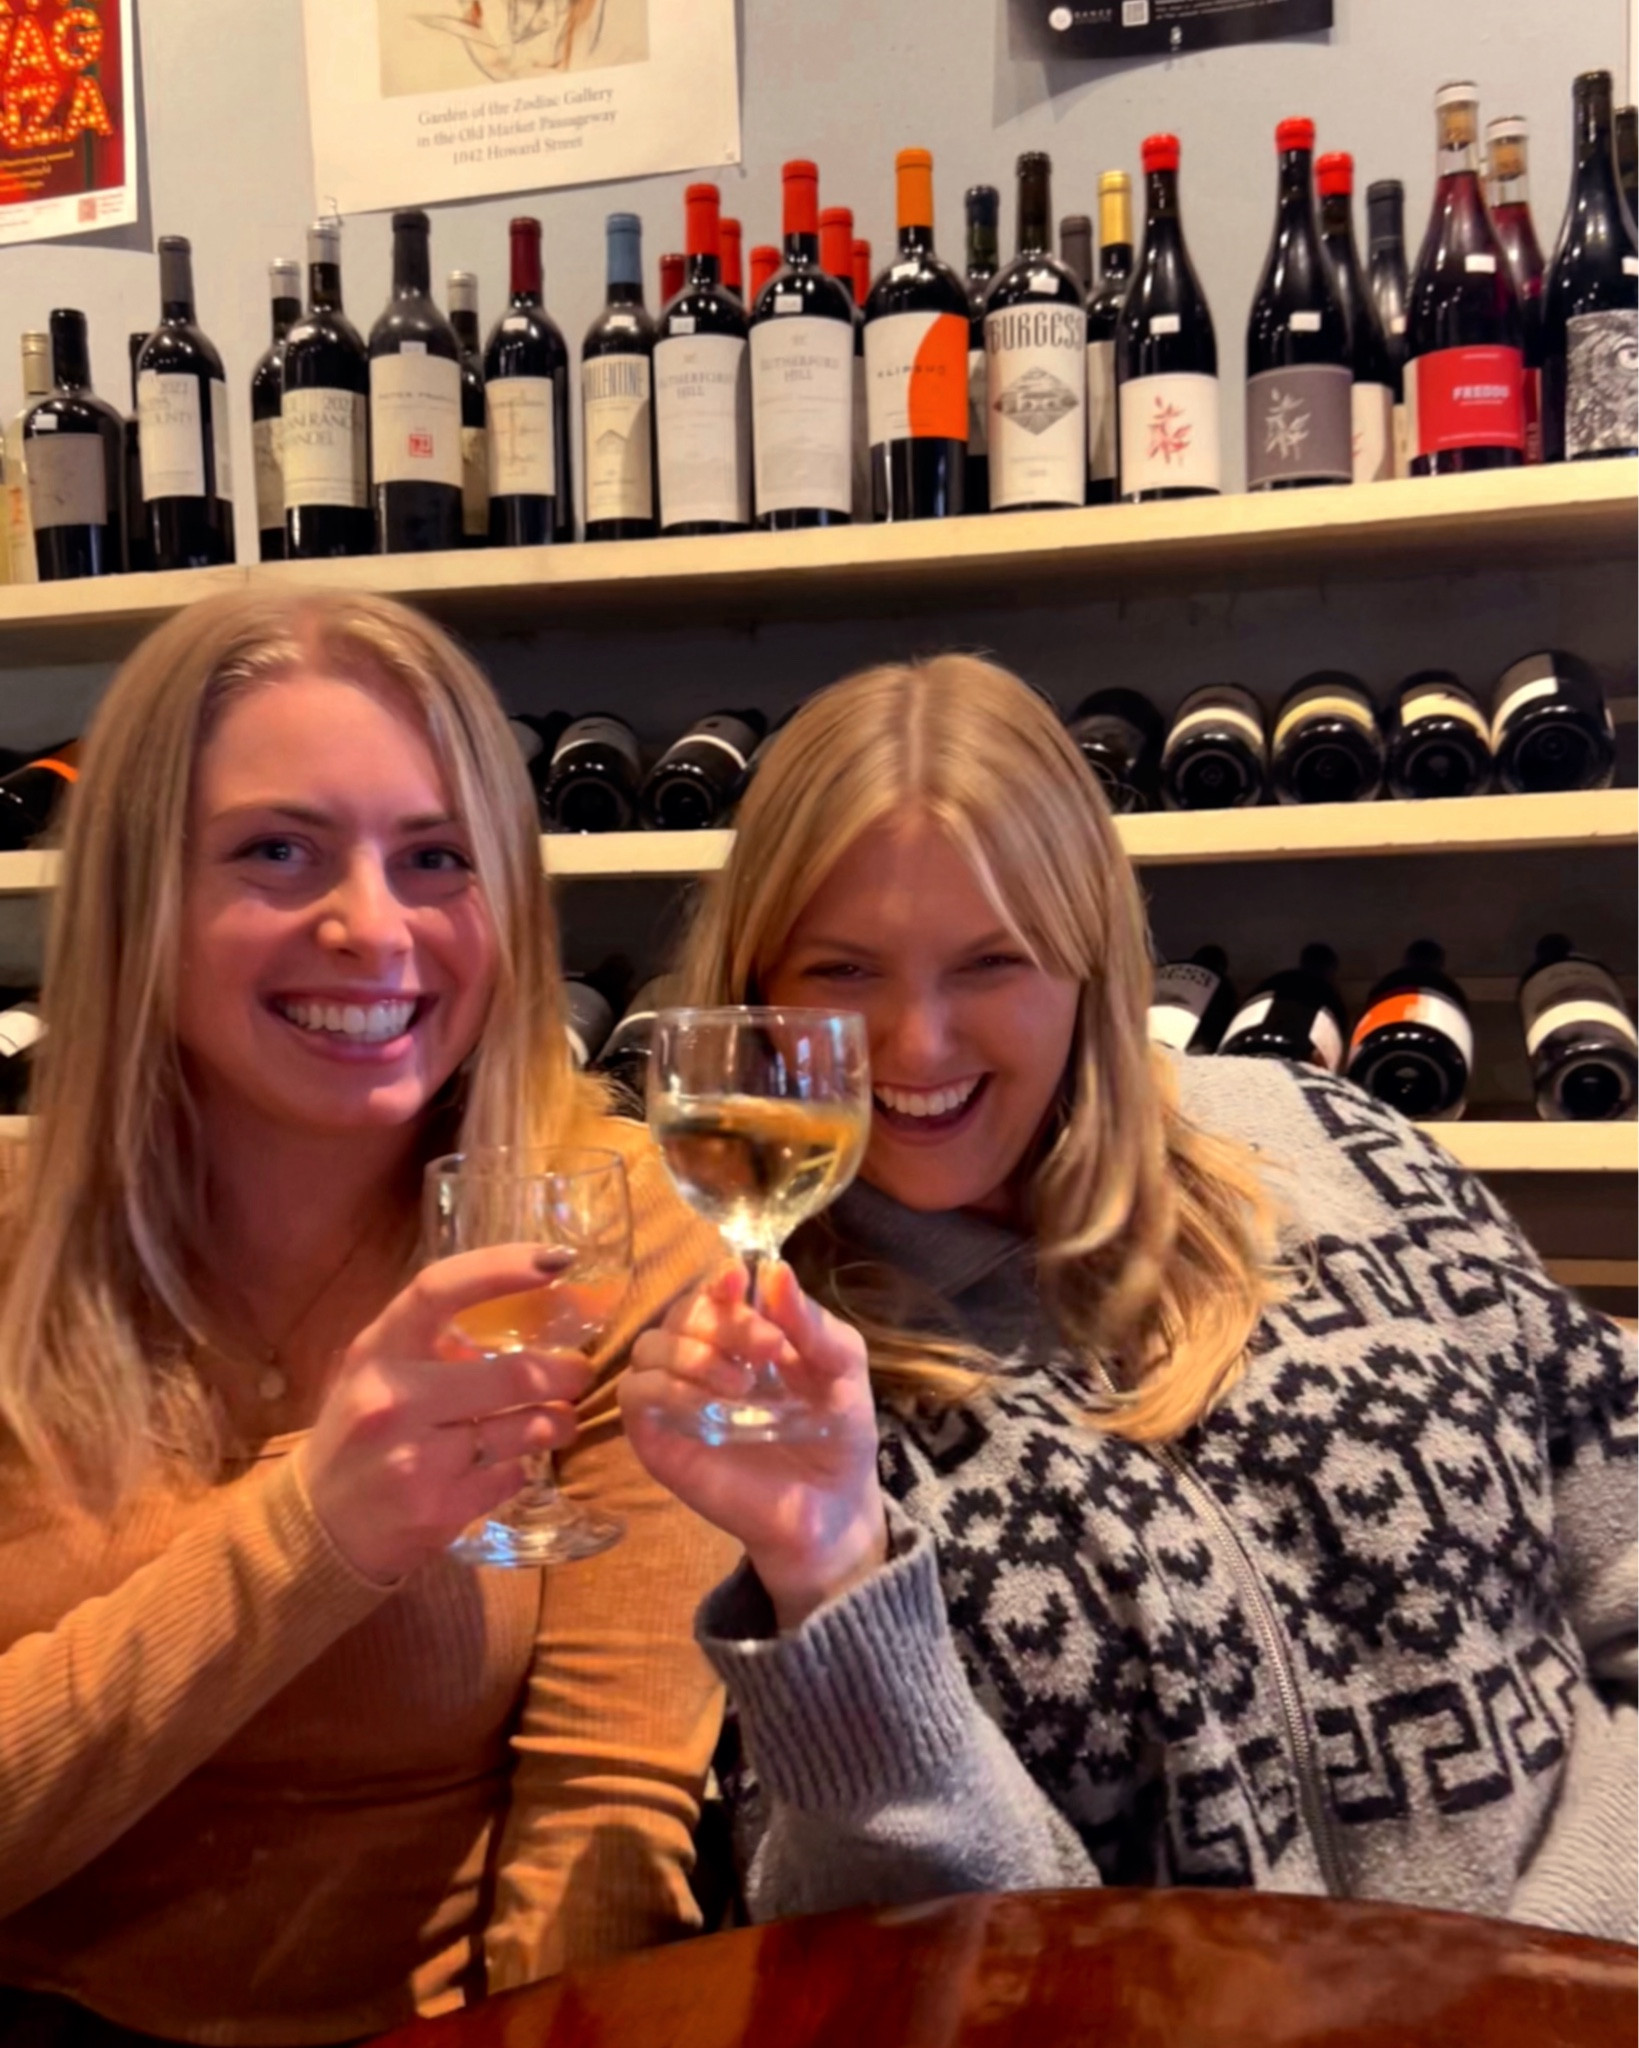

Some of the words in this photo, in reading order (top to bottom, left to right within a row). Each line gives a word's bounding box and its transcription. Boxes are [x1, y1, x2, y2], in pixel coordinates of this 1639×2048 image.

[0, 7, 103, 83] AG
[418, 107, 468, 126] Garden
[472, 103, 485, 118] of
[488, 100, 510, 115] the
[513, 95, 559, 113] Zodiac
[563, 87, 614, 105] Gallery
[417, 134, 430, 148] in
[434, 130, 455, 146] the
[458, 125, 484, 143] Old
[487, 121, 536, 139] Market
[539, 109, 618, 131] Passageway
[453, 148, 483, 165] 1042
[487, 139, 541, 161] Howard
[544, 136, 583, 153] Street
